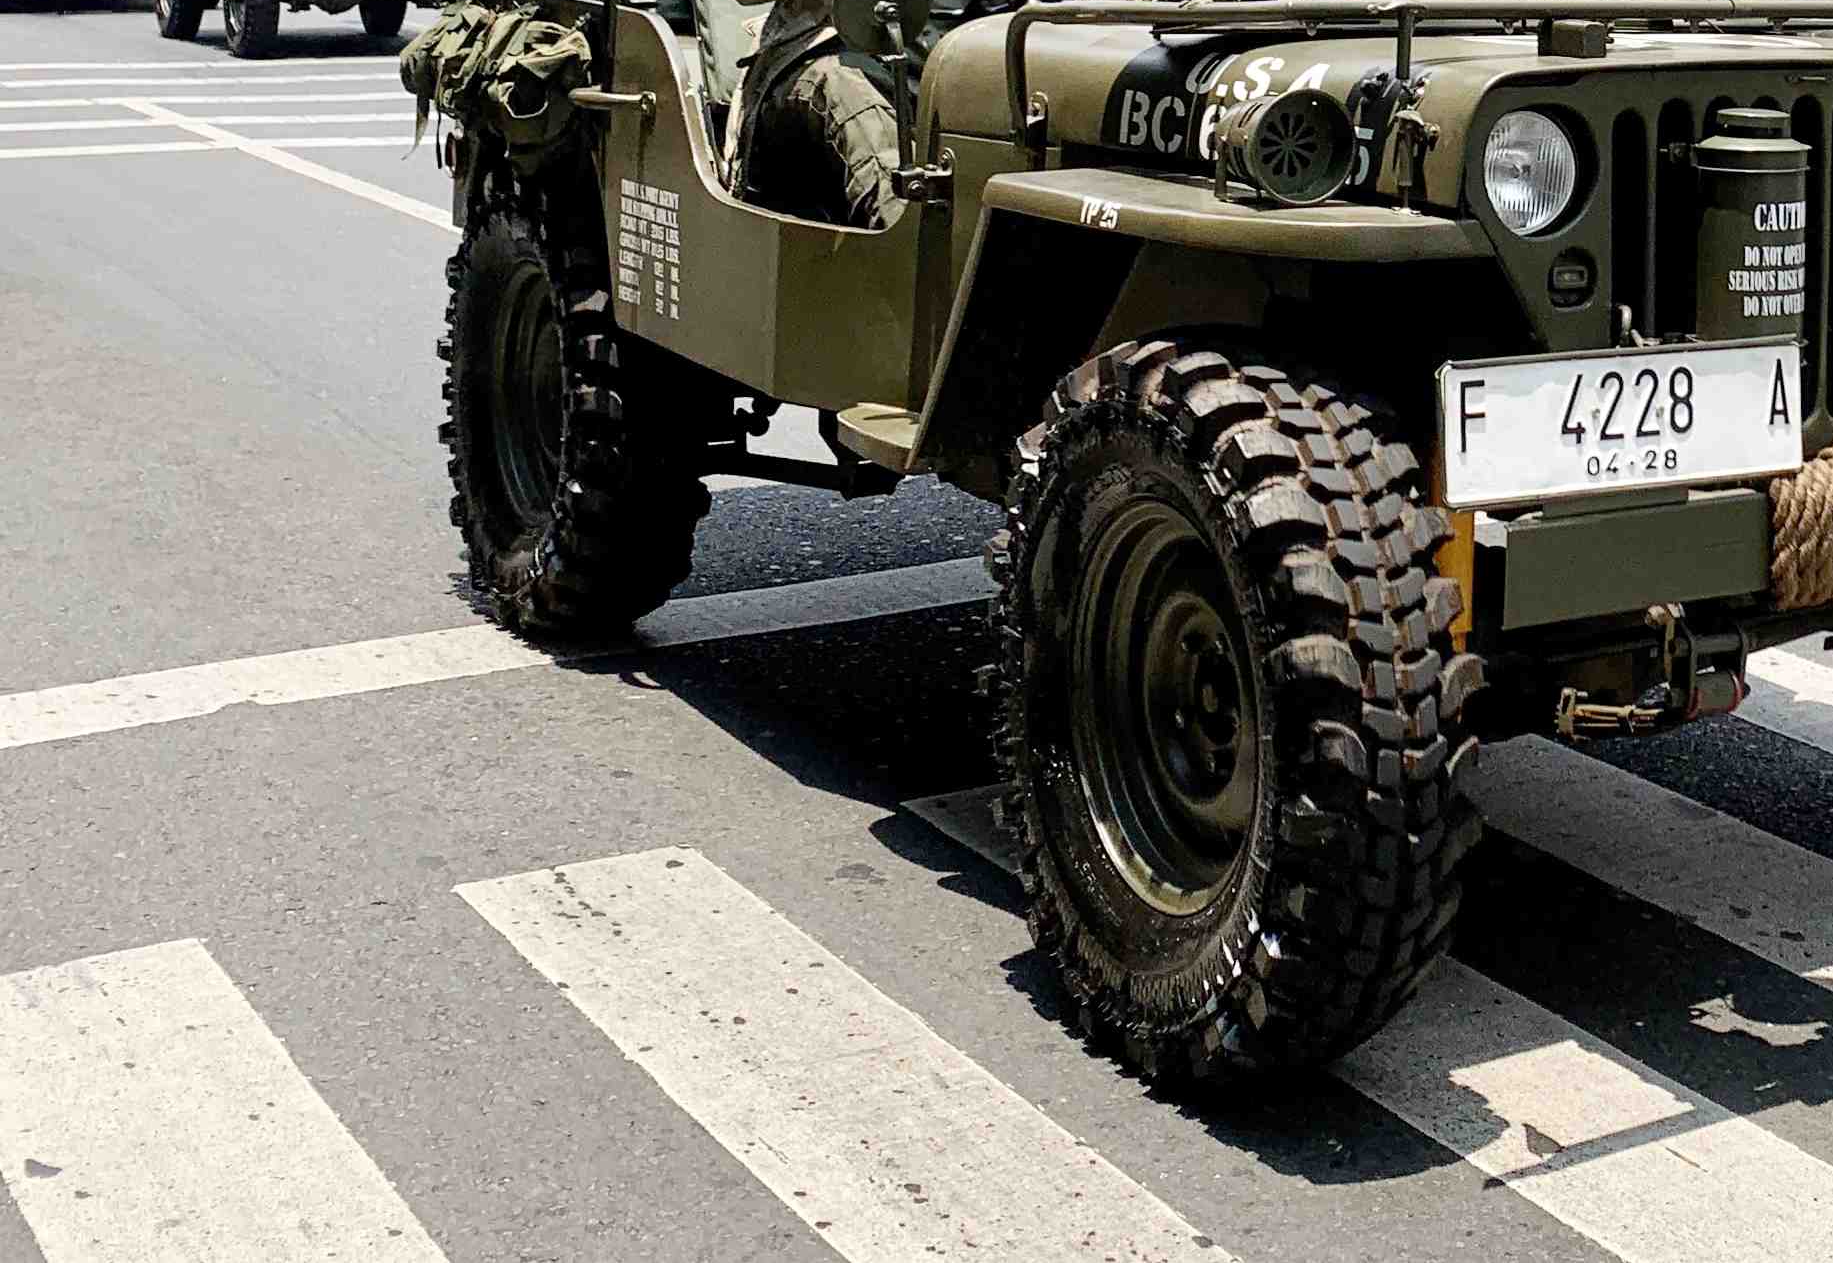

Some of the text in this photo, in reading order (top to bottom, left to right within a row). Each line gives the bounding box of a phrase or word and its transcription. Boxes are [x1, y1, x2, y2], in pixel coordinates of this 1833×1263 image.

[1119, 90, 1186, 154] BC
[1744, 245, 1761, 267] DO
[1762, 246, 1783, 268] NOT
[1728, 270, 1777, 291] SERIOUS
[1777, 269, 1798, 291] RISK
[1743, 295, 1760, 317] DO
[1761, 295, 1782, 316] NOT
[1459, 357, 1791, 454] F 4228 A
